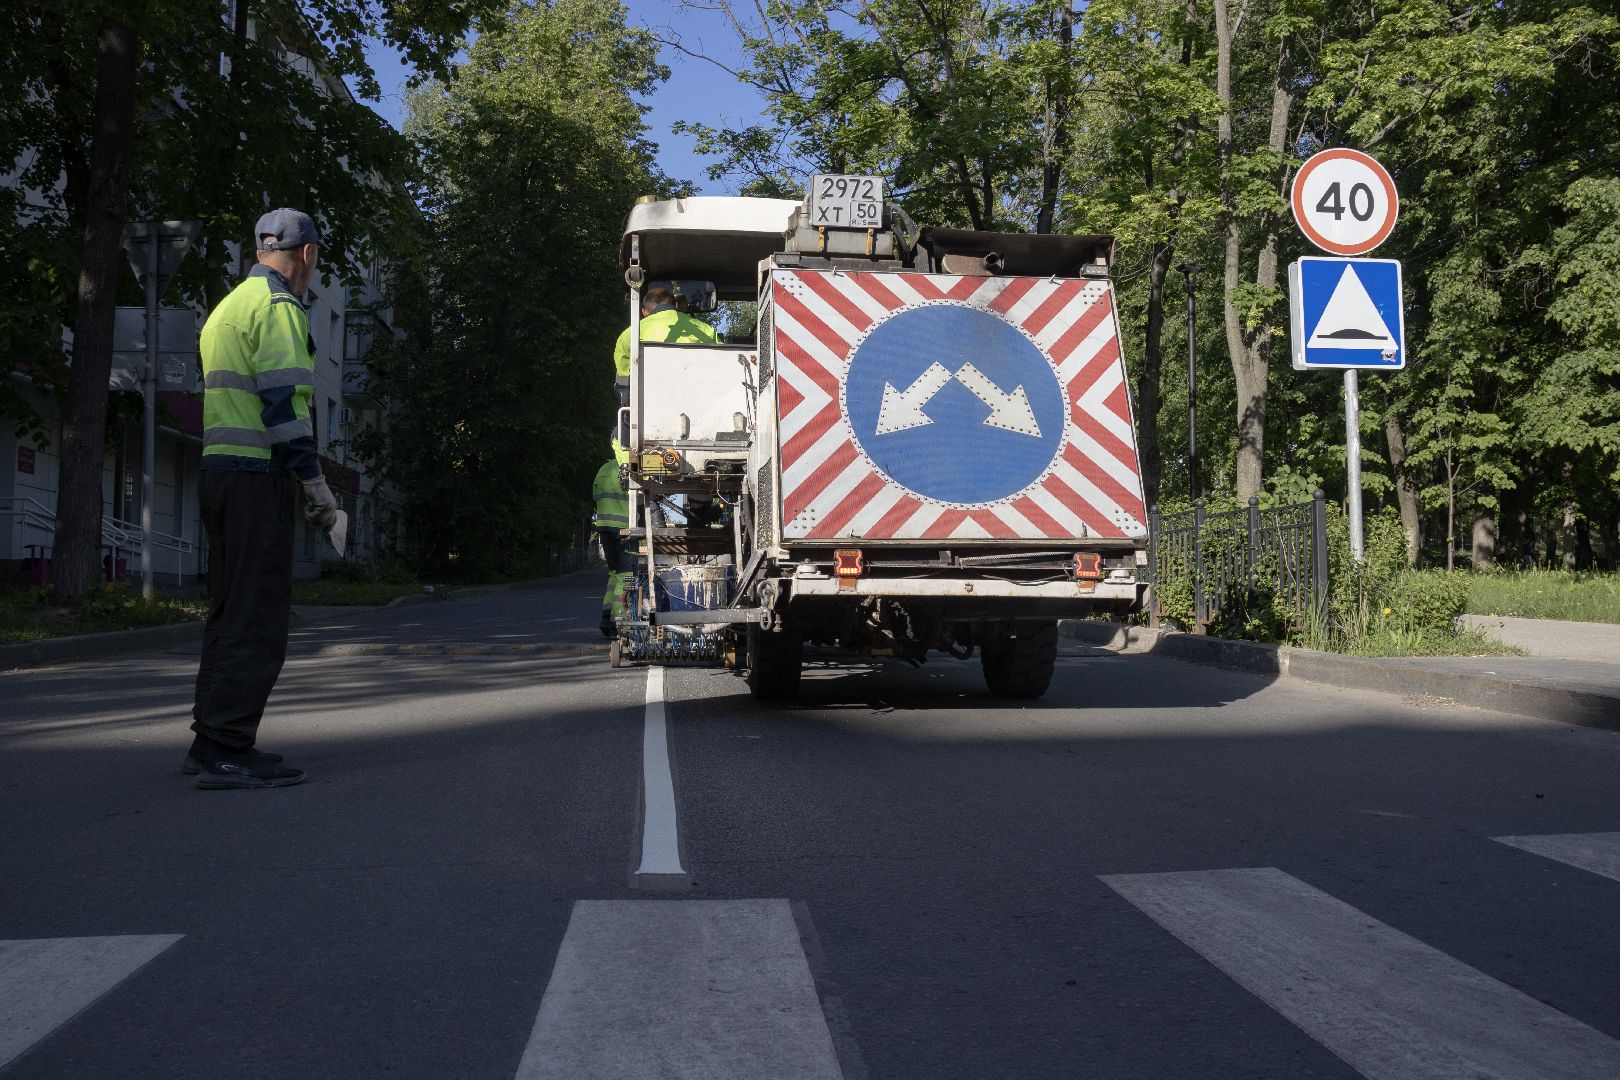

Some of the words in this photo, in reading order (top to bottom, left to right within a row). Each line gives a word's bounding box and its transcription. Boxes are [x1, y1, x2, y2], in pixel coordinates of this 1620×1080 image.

[821, 177, 874, 199] 2972
[1315, 181, 1375, 222] 40
[818, 206, 843, 223] XT
[856, 203, 877, 219] 50
